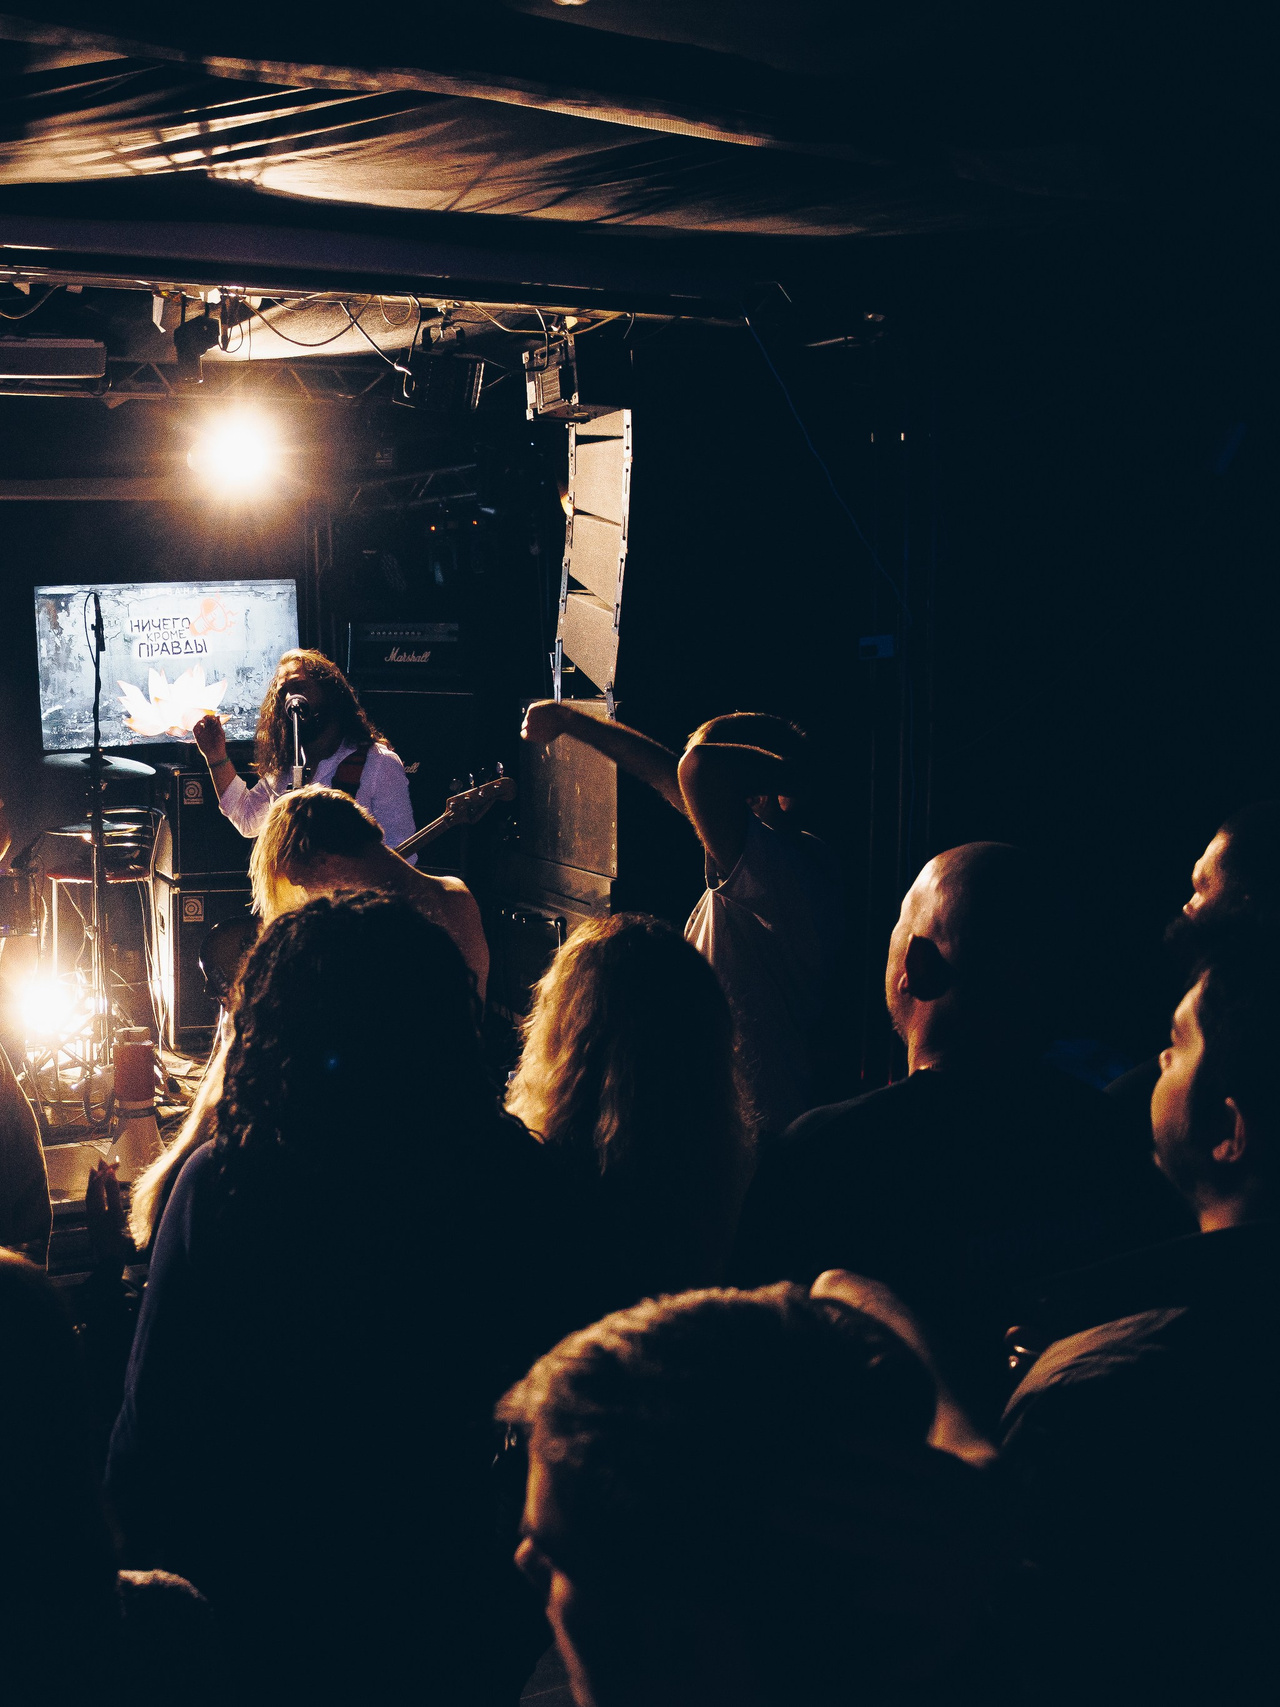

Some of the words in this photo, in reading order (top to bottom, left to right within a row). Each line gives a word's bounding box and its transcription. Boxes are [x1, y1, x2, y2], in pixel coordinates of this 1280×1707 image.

[140, 587, 199, 596] НВАНА
[130, 617, 191, 633] НИЧЕГО
[146, 629, 187, 642] КРОМЕ
[138, 638, 208, 658] ПРАВДЫ
[384, 646, 431, 663] Marshall
